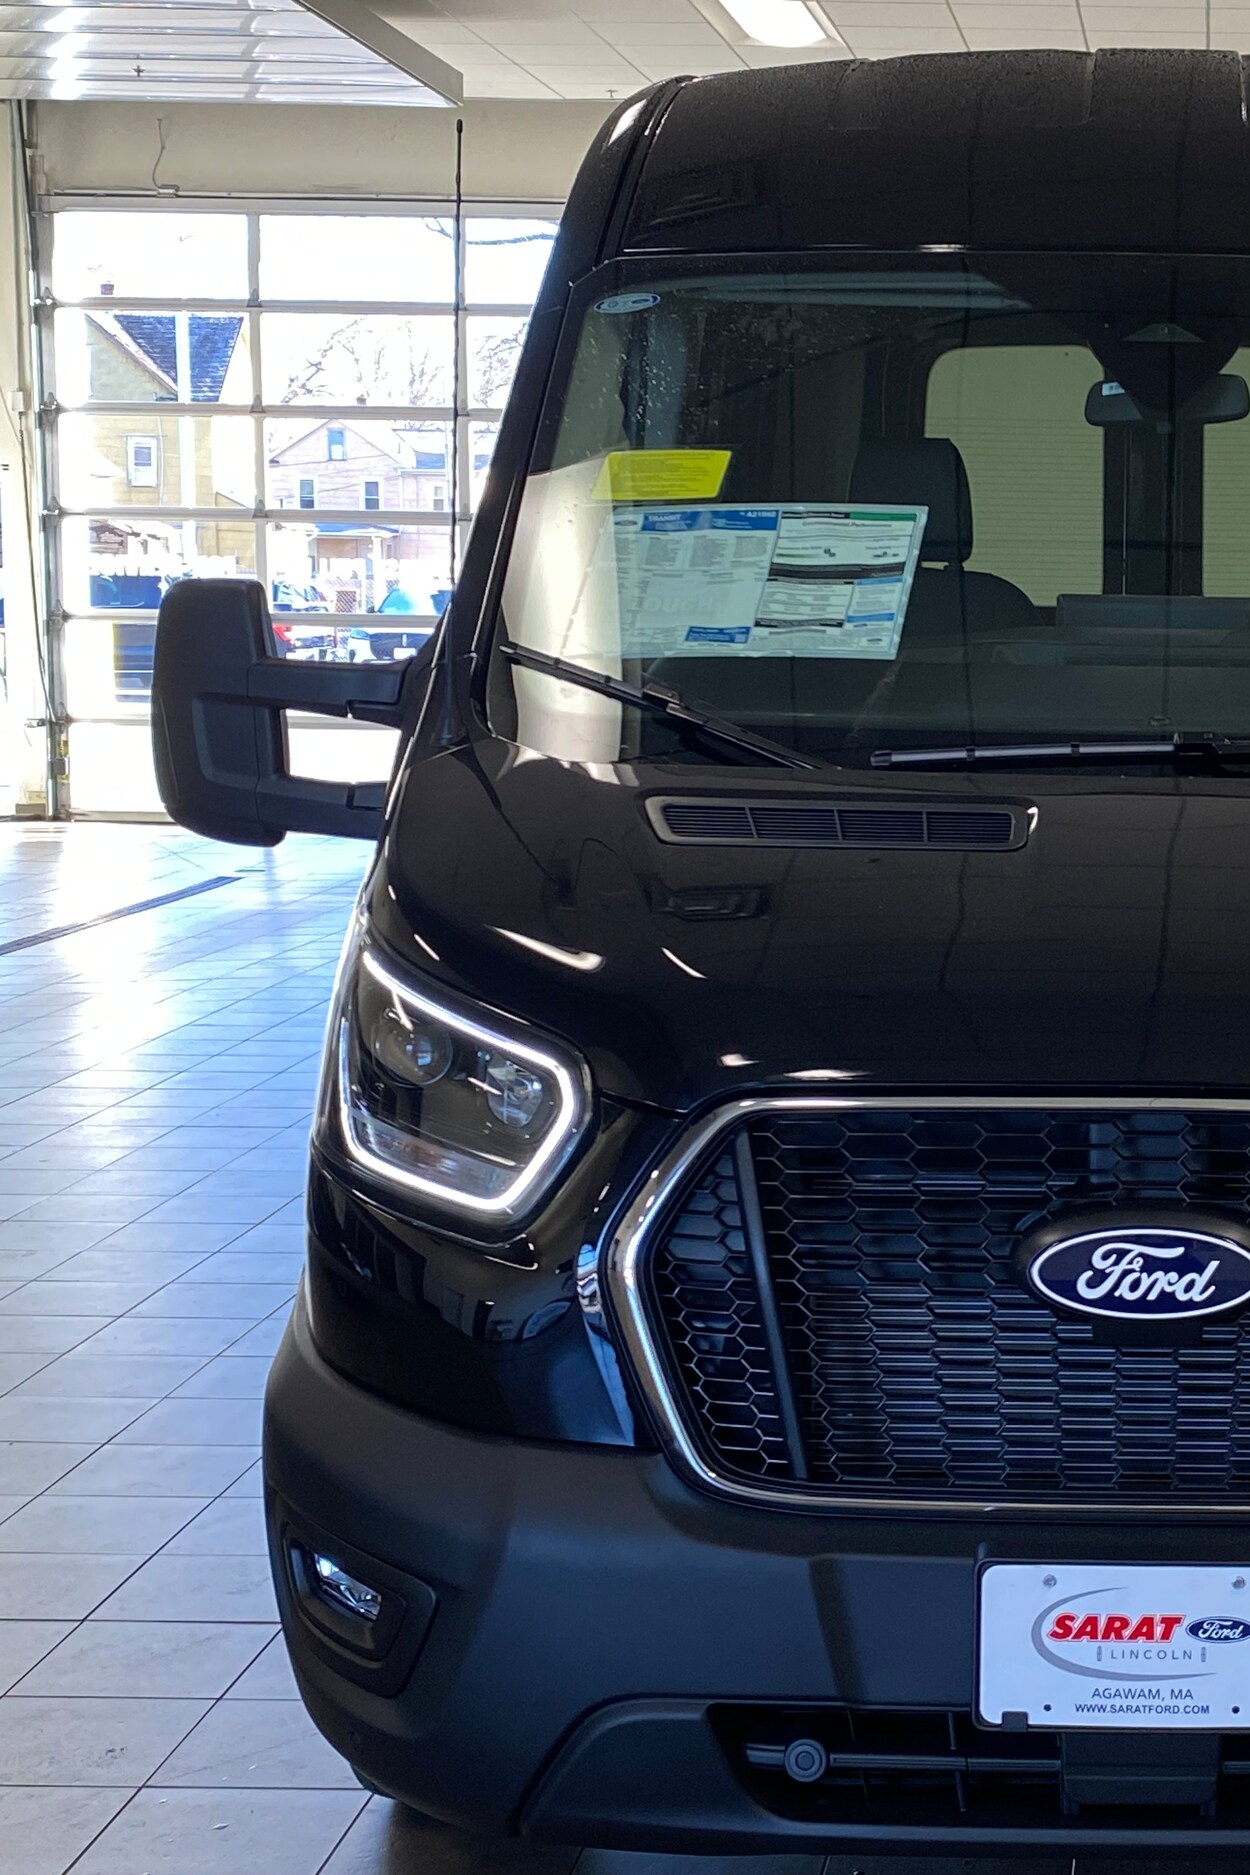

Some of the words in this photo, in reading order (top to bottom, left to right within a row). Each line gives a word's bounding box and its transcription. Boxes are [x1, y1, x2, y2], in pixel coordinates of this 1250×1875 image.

[1076, 1242, 1220, 1302] Ford
[1048, 1612, 1184, 1642] SARAT
[1199, 1620, 1243, 1640] Ford
[1110, 1649, 1193, 1661] LINCOLN
[1091, 1688, 1166, 1701] AGAWAM,
[1171, 1688, 1194, 1701] MA
[1075, 1703, 1210, 1715] WWW.SARATFORD.COM
